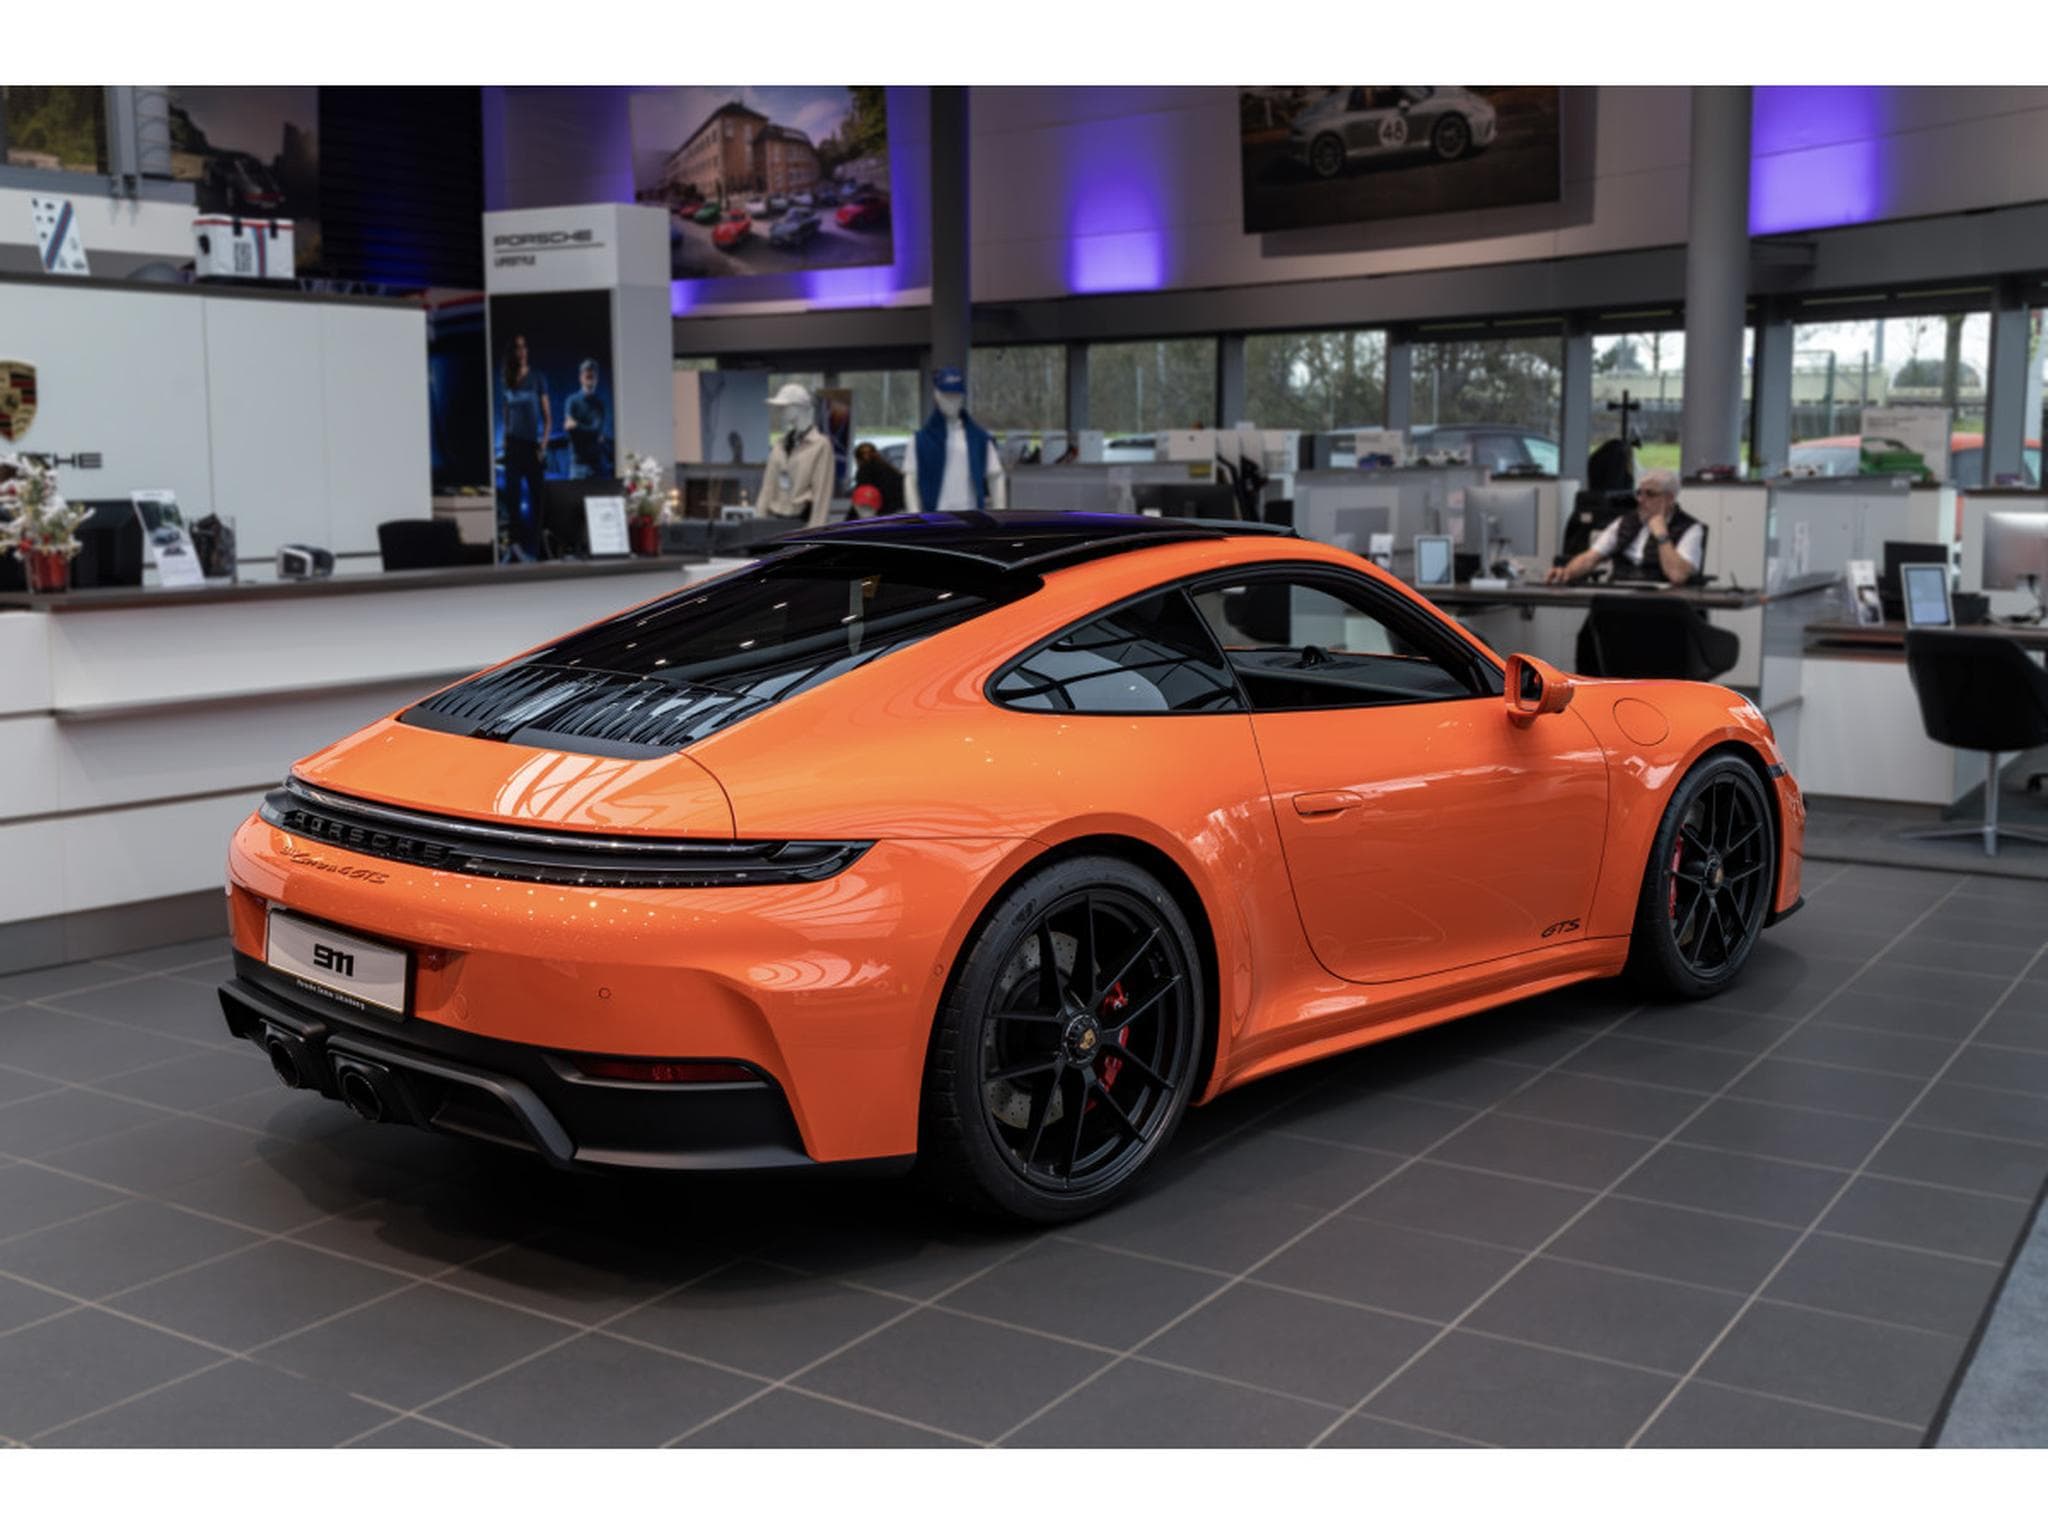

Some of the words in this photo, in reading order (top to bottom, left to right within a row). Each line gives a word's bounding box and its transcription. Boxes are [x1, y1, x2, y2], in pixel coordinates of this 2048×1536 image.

[493, 229, 593, 246] PORSCHE
[294, 810, 443, 861] PORSCHE
[1541, 917, 1581, 938] GTS
[313, 943, 354, 977] 911
